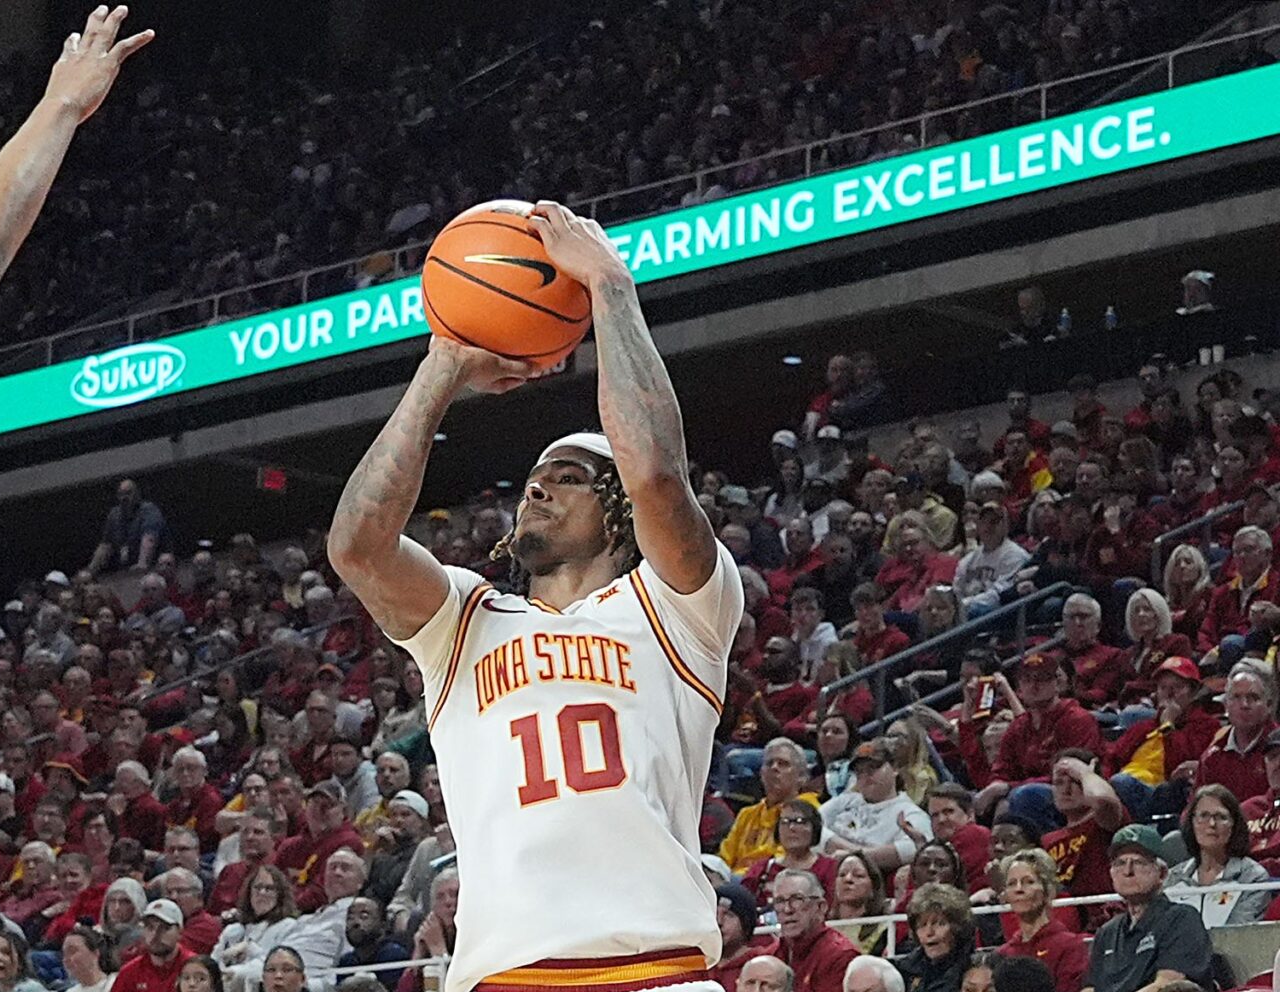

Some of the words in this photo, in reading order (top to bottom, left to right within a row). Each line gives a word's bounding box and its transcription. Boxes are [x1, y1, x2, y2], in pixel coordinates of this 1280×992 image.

[608, 191, 816, 272] FARMING
[832, 106, 1173, 223] EXCELLENCE.
[228, 308, 334, 366] YOUR
[347, 286, 426, 339] PAR
[83, 353, 175, 395] Sukup
[474, 635, 531, 716] IOWA
[533, 632, 638, 695] STATE
[509, 702, 628, 809] 10
